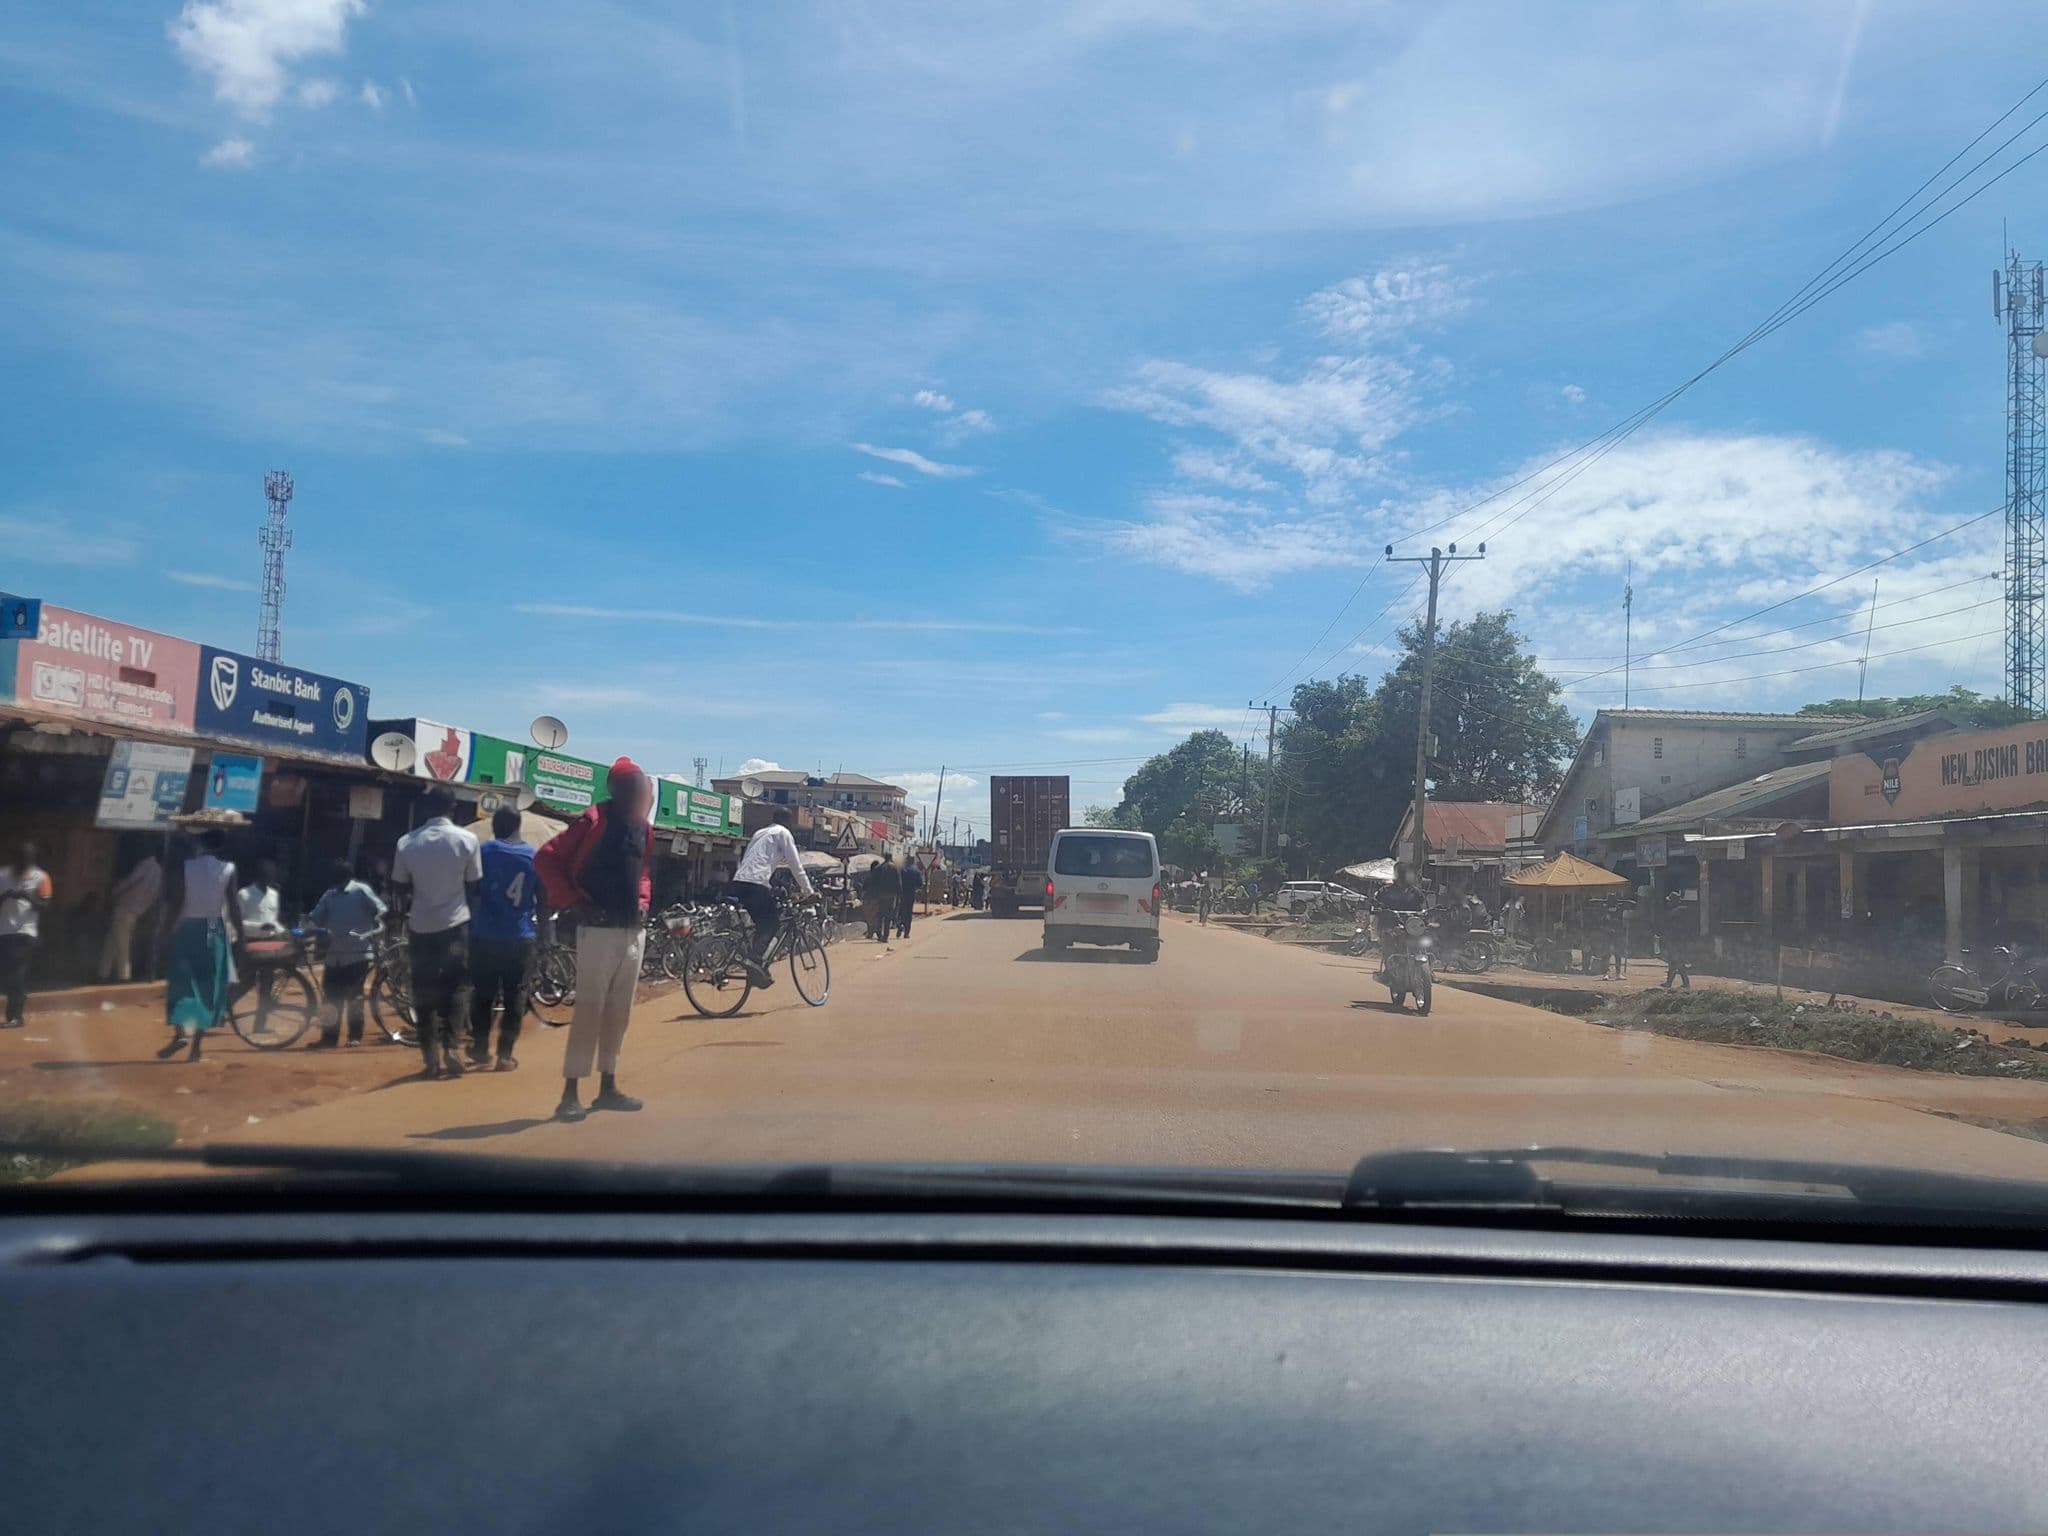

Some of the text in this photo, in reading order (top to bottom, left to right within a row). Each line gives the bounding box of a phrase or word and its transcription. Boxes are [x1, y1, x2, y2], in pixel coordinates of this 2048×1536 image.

[34, 613, 153, 668] Satellite TV
[251, 667, 320, 701] Stanbic Bank
[1883, 778, 1899, 789] NILE
[1942, 752, 1968, 786] NEW
[505, 871, 526, 907] 4
